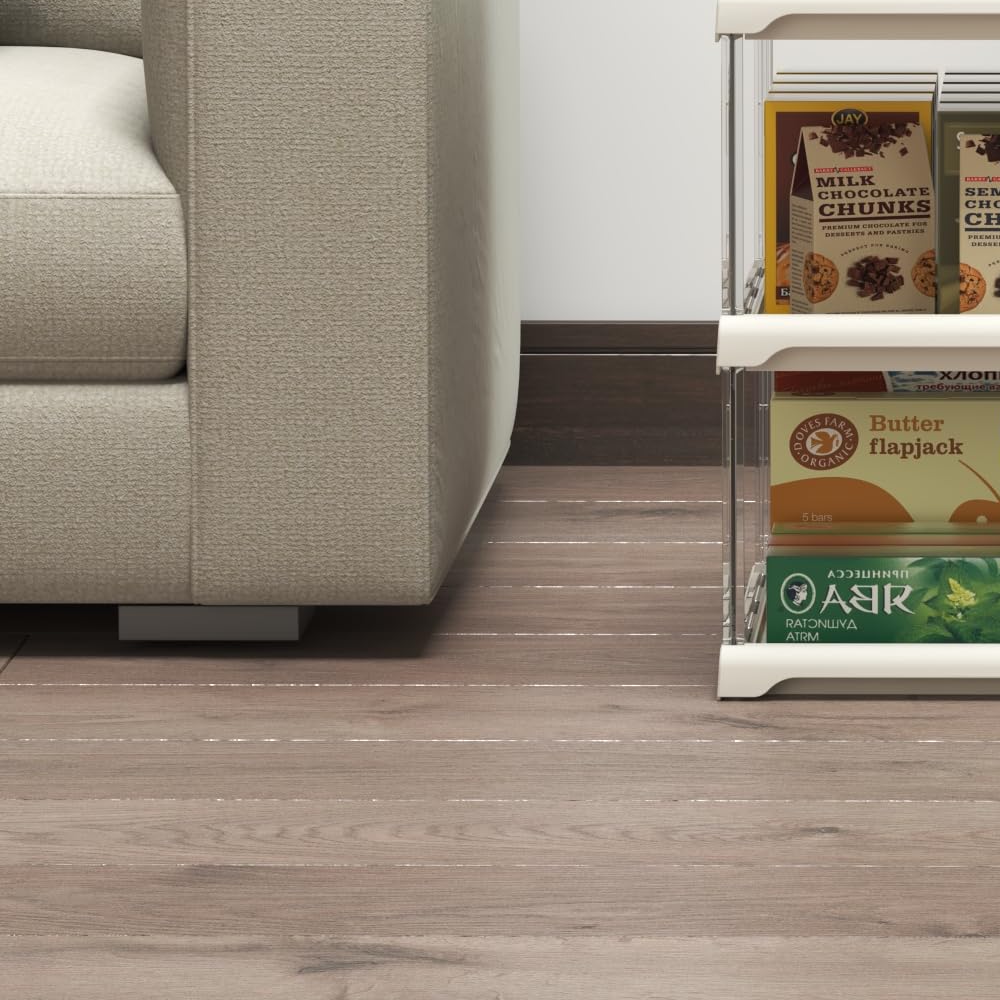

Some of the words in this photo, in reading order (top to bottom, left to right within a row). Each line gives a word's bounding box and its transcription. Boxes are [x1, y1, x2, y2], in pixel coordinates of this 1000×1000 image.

[837, 113, 862, 125] JAY
[816, 176, 875, 188] MILK
[818, 187, 930, 200] CHOCOLATE
[819, 200, 931, 216] CHUNKS
[869, 415, 944, 432] Butter
[793, 419, 821, 450] DOVES
[825, 416, 854, 438] FARM
[801, 442, 854, 467] ORGANIC
[869, 438, 963, 459] flapjack
[802, 512, 809, 521] 5
[811, 512, 832, 521] bars
